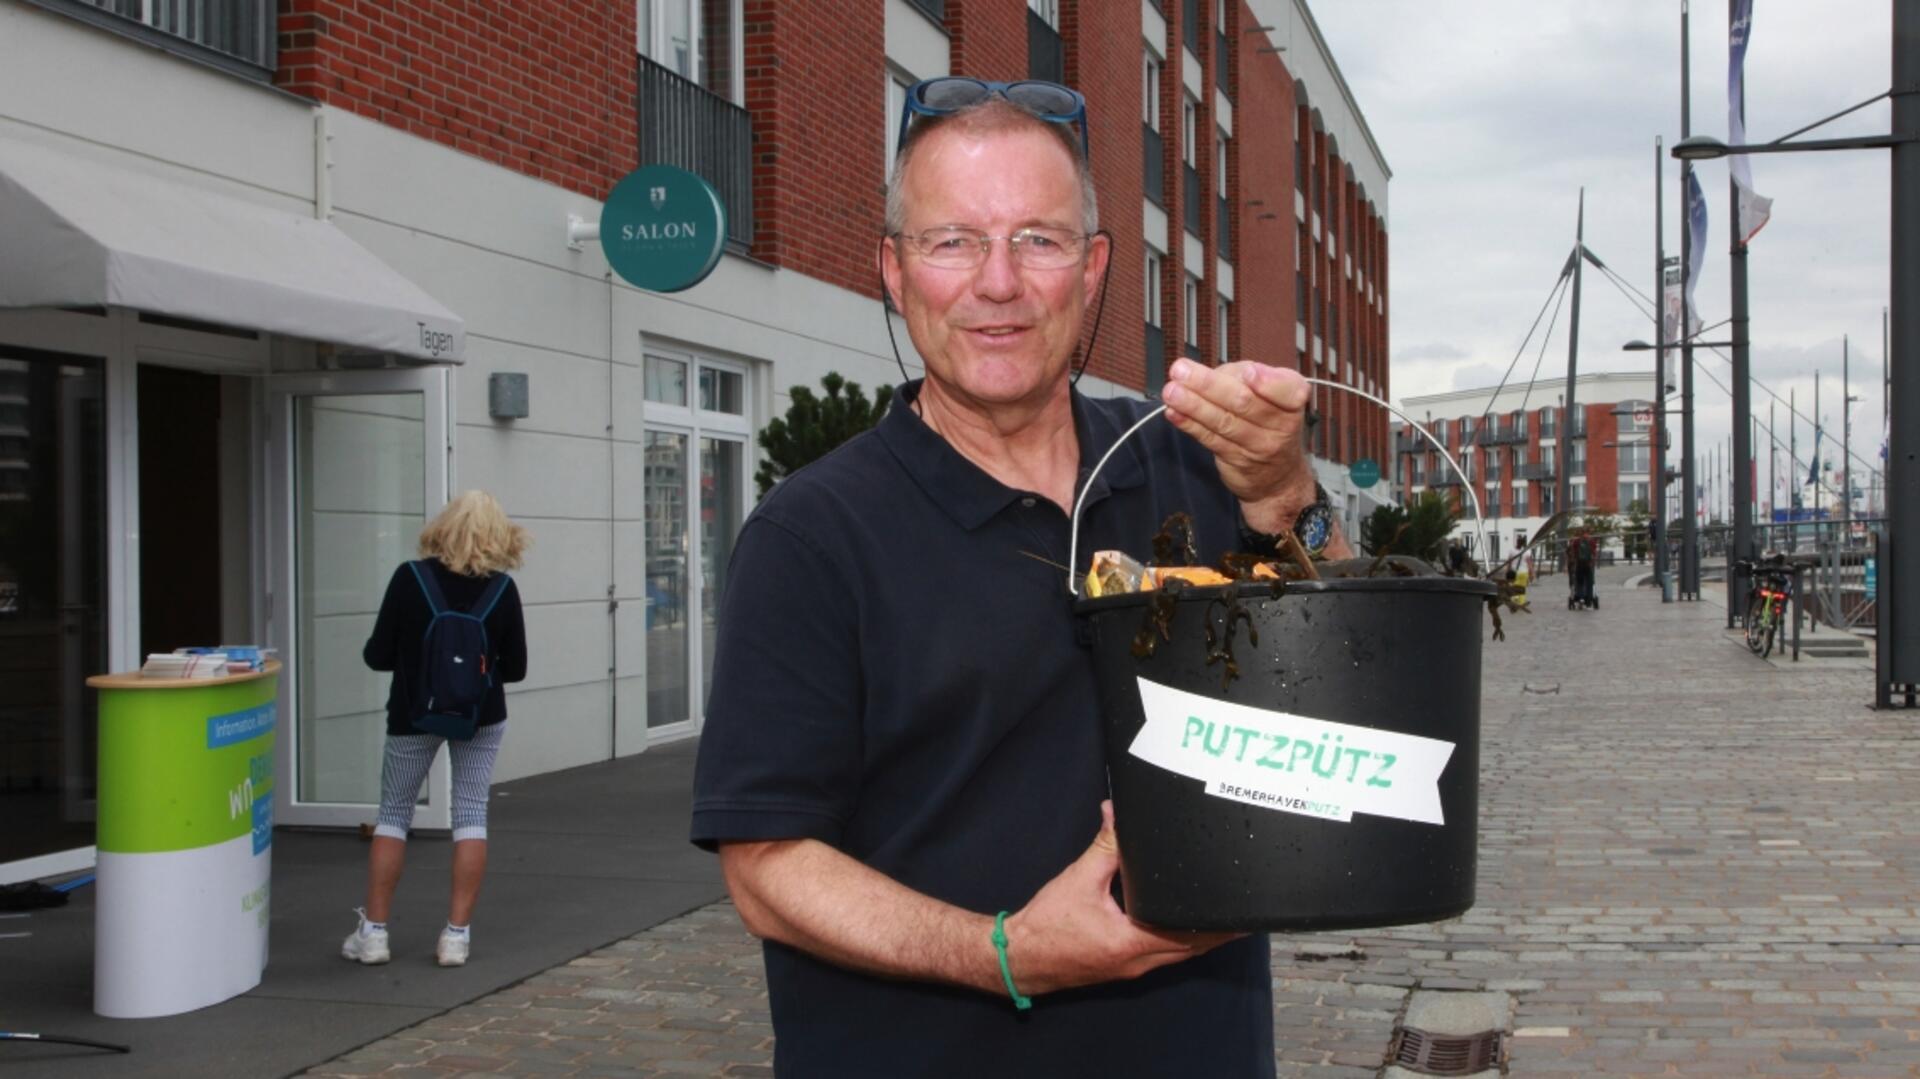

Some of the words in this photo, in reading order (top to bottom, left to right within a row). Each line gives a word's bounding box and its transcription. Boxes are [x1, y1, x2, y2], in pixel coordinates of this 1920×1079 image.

[622, 222, 696, 240] SALON
[417, 321, 453, 357] Tagen
[1182, 716, 1396, 788] PUTZPÜTZ
